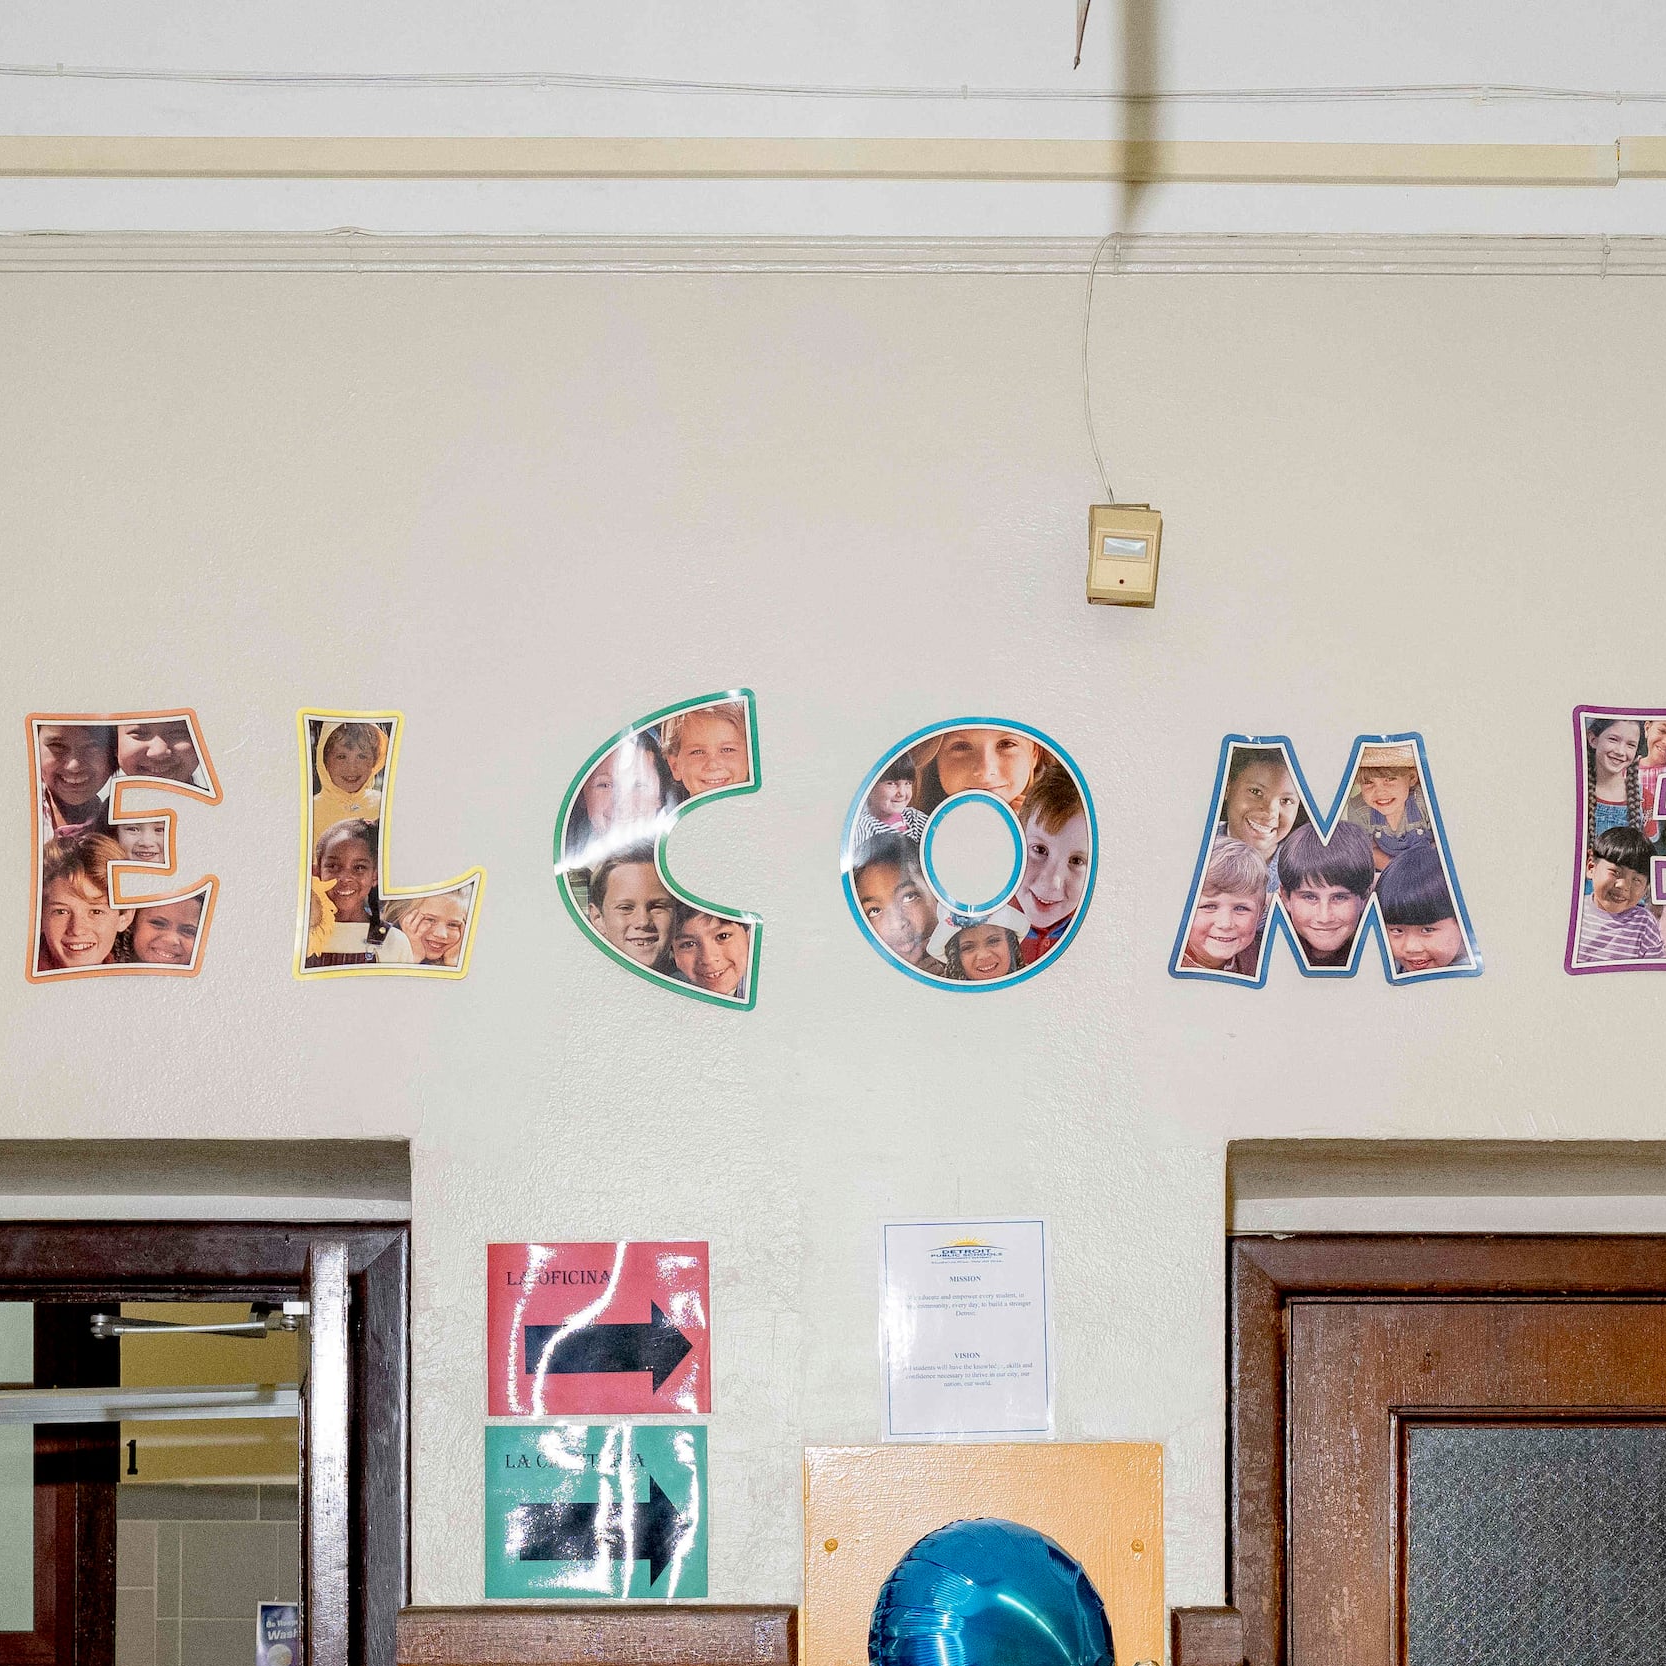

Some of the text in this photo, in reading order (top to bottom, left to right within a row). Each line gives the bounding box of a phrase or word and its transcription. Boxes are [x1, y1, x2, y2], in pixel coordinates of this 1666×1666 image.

[538, 1270, 612, 1285] OFICINA
[126, 1440, 139, 1475] 1
[505, 1454, 530, 1468] LA
